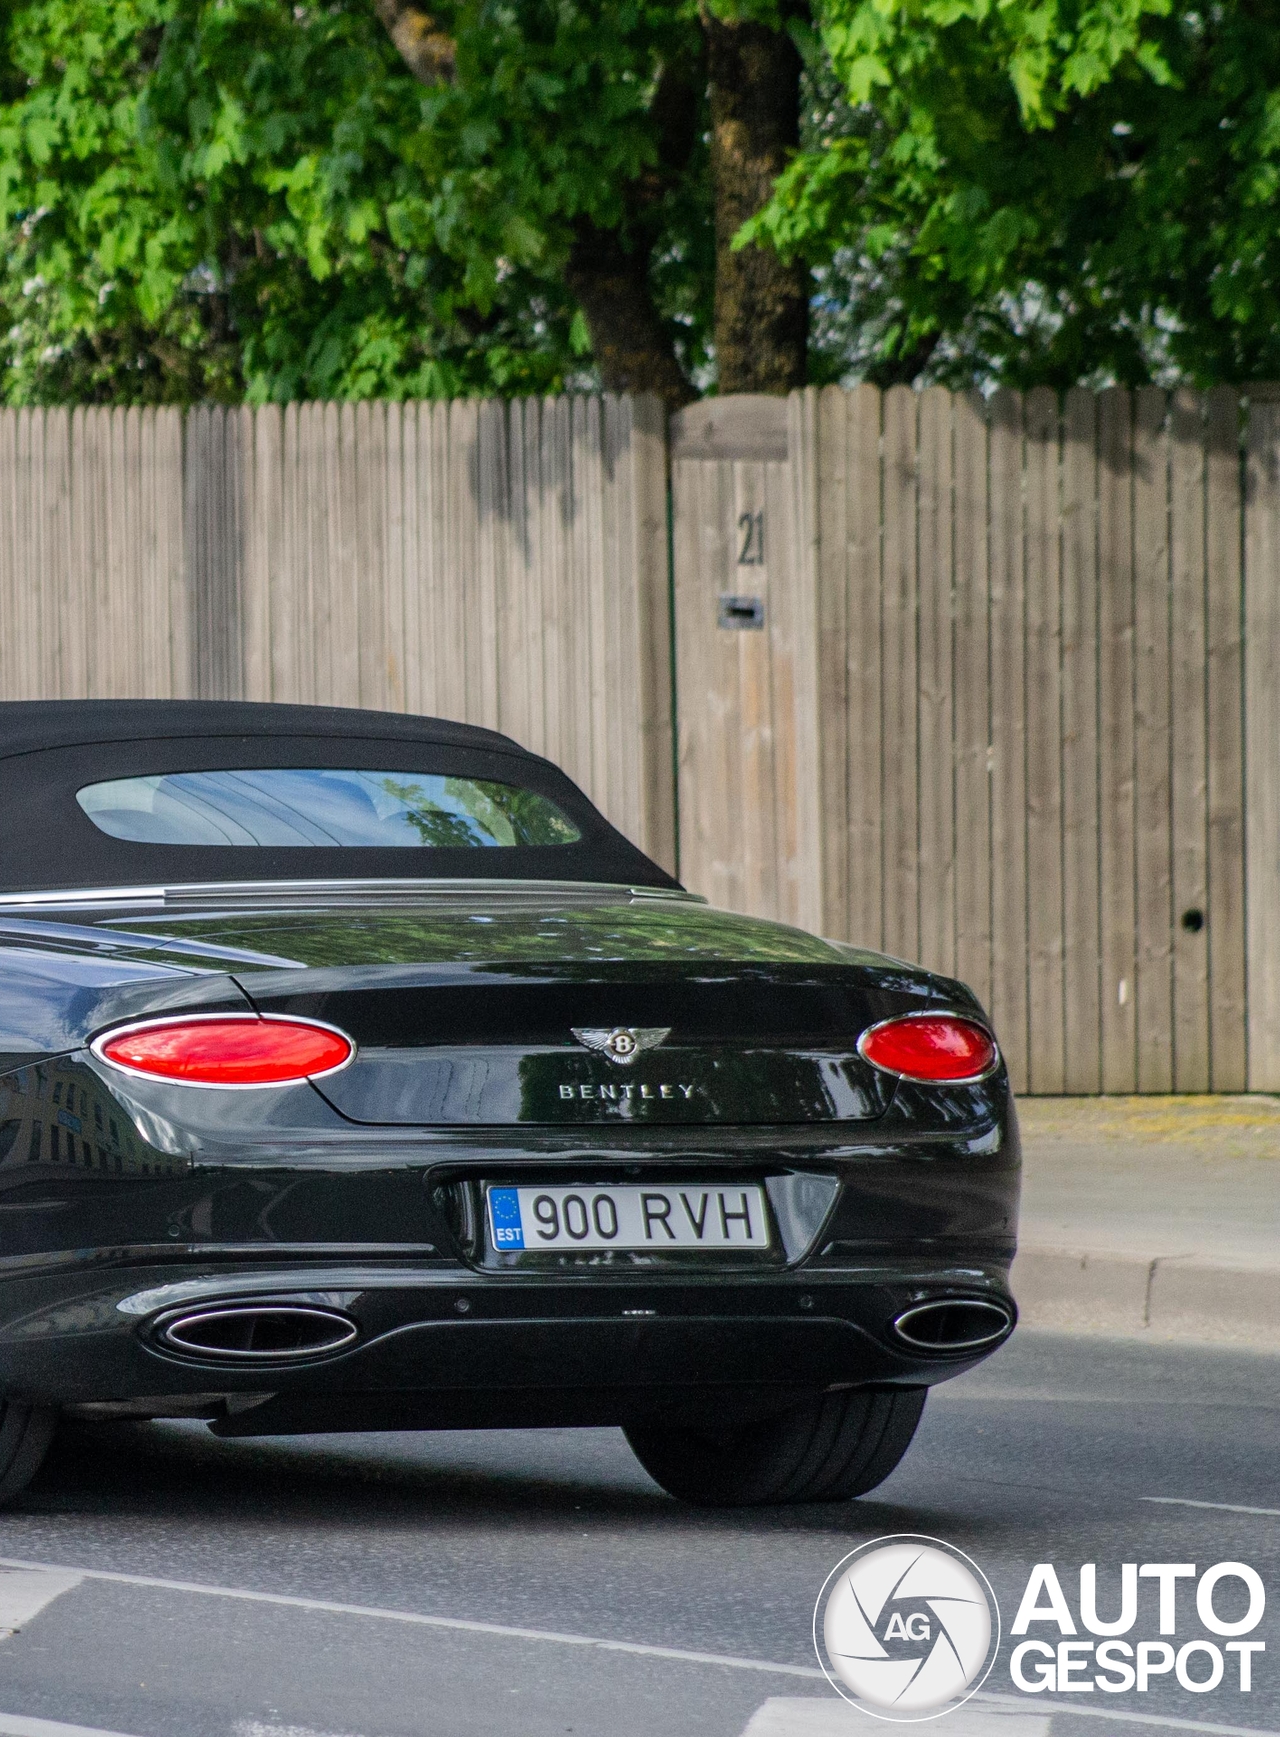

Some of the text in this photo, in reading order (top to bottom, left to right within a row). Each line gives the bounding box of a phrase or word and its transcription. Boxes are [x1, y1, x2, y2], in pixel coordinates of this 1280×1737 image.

[738, 511, 764, 565] 21
[615, 1035, 631, 1053] B
[558, 1084, 693, 1099] BENTLEY
[532, 1193, 754, 1240] 900 RVH
[496, 1228, 522, 1241] EST
